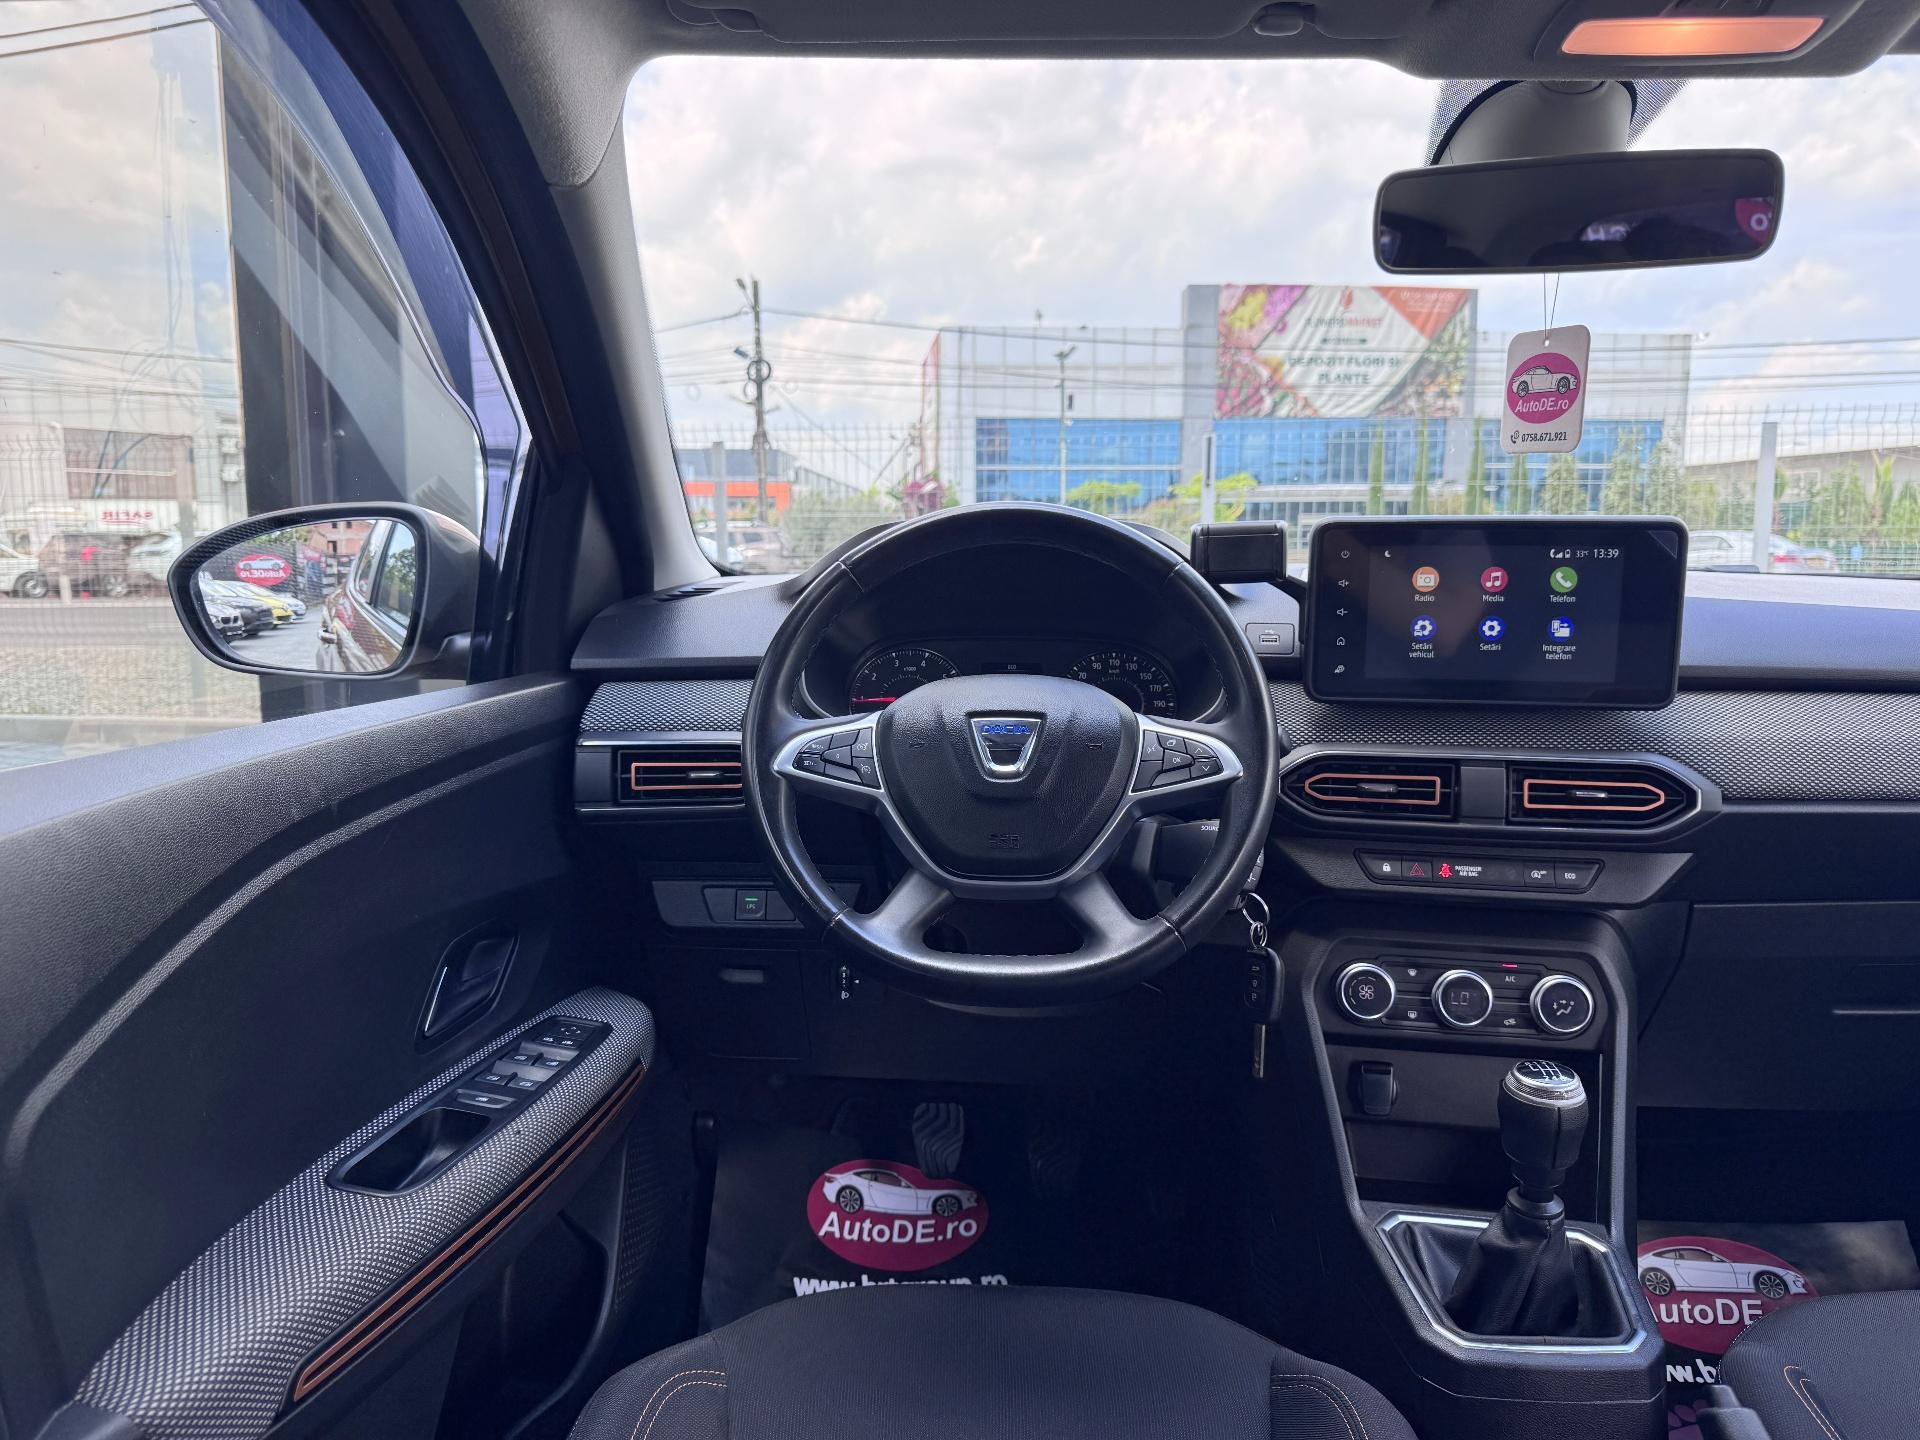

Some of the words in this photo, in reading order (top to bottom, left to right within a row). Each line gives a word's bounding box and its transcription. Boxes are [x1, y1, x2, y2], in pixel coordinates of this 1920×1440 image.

[1514, 397, 1569, 413] AutoDE.ro
[1521, 431, 1568, 443] 0758.671.921
[1593, 548, 1619, 559] 13:39
[1414, 594, 1435, 602] Radio
[1482, 594, 1504, 602] Media
[1549, 594, 1576, 603] Telefon
[1542, 644, 1576, 653] Integrare
[1409, 651, 1434, 659] vehicul
[1545, 652, 1572, 660] telefon
[1078, 672, 1087, 680] 70
[1140, 672, 1152, 680] 150
[981, 725, 1030, 735] DACIA
[818, 1211, 978, 1244] AutoDE.ro
[1645, 1296, 1763, 1326] utoDE
